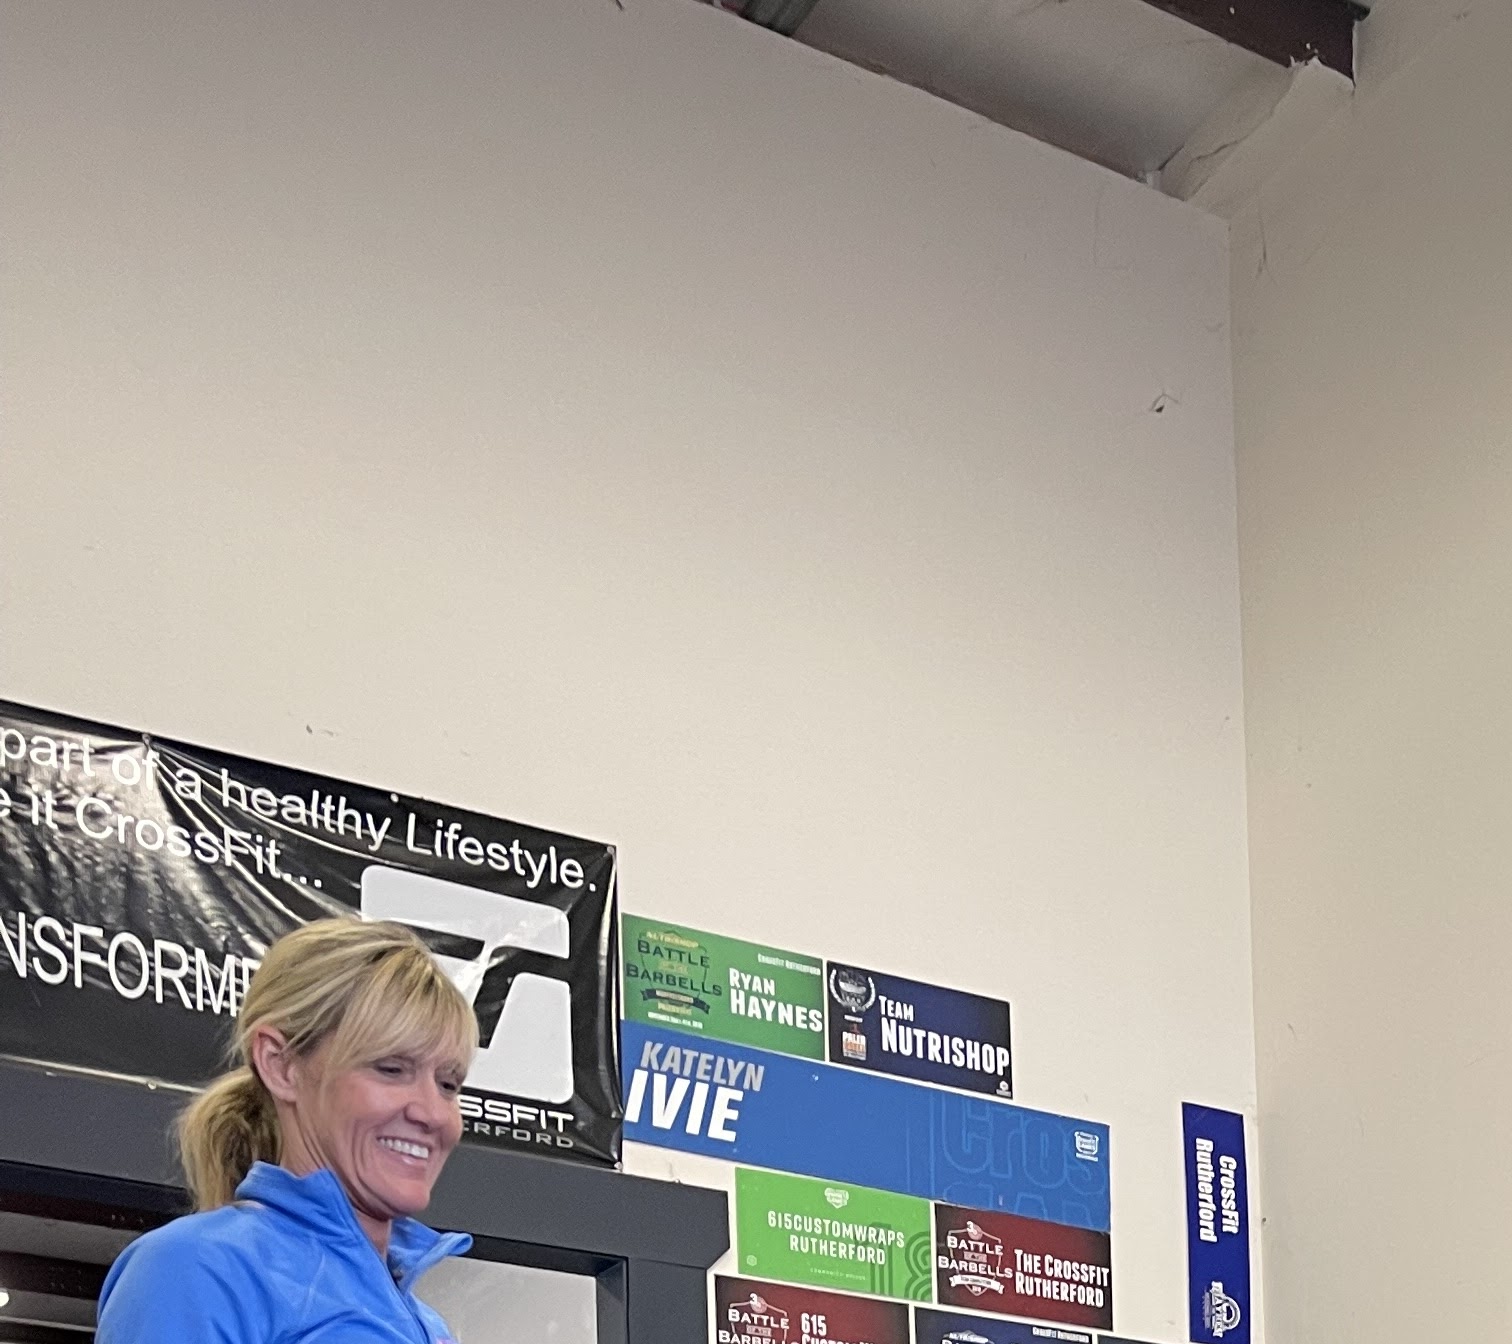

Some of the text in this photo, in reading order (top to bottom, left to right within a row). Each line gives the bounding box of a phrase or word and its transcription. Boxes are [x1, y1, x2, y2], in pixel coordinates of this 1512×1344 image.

[0, 726, 597, 892] part of a healthy Lifestyle.
[31, 784, 58, 829] it
[0, 911, 261, 1017] NSFORM
[637, 939, 710, 969] BATTLE
[625, 963, 722, 996] BARBELLS
[729, 967, 776, 996] RYAN
[730, 988, 823, 1033] HAYNES
[878, 995, 914, 1022] TEAM
[640, 1040, 765, 1092] KATELYN
[880, 1017, 1010, 1076] NUTRISHOP
[457, 1094, 575, 1133] SSFIT
[624, 1068, 744, 1143] IVIE
[1195, 1137, 1218, 1243] Rutherford
[1219, 1155, 1240, 1234] CrossFit
[767, 1210, 905, 1249] 615CUSTOMWRAPS
[946, 1235, 1003, 1256] BATTLE
[789, 1234, 886, 1266] RUTHERFORD
[938, 1255, 1013, 1278] BARBELLS
[1014, 1248, 1110, 1287] THE CROSSFIT
[1015, 1271, 1104, 1309] RUTHERFORD
[728, 1308, 789, 1329] BATTLE
[801, 1312, 827, 1337] 615
